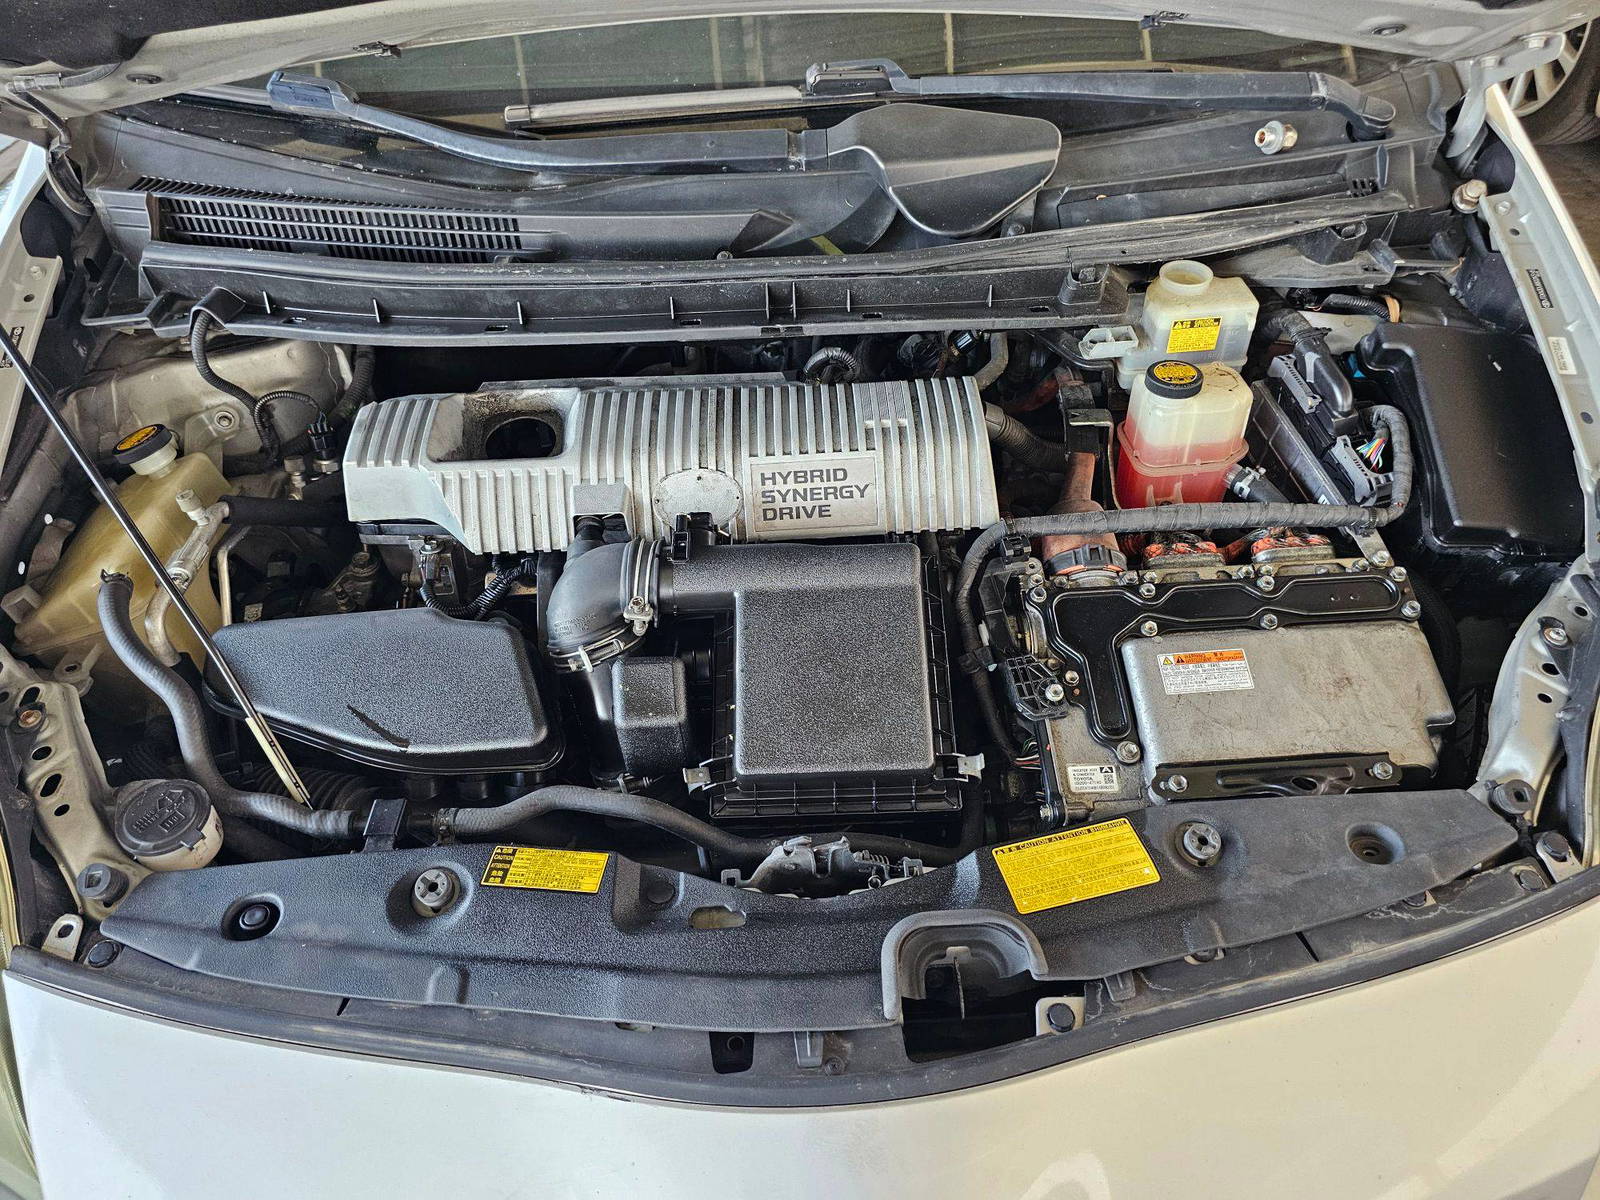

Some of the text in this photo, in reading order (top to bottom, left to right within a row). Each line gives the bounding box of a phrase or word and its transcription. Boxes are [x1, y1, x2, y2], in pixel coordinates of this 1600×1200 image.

[760, 468, 848, 486] HYBRID
[761, 483, 871, 504] SYNERGY
[762, 504, 832, 521] DRIVE
[1019, 830, 1088, 849] CAUTION ATTENTION
